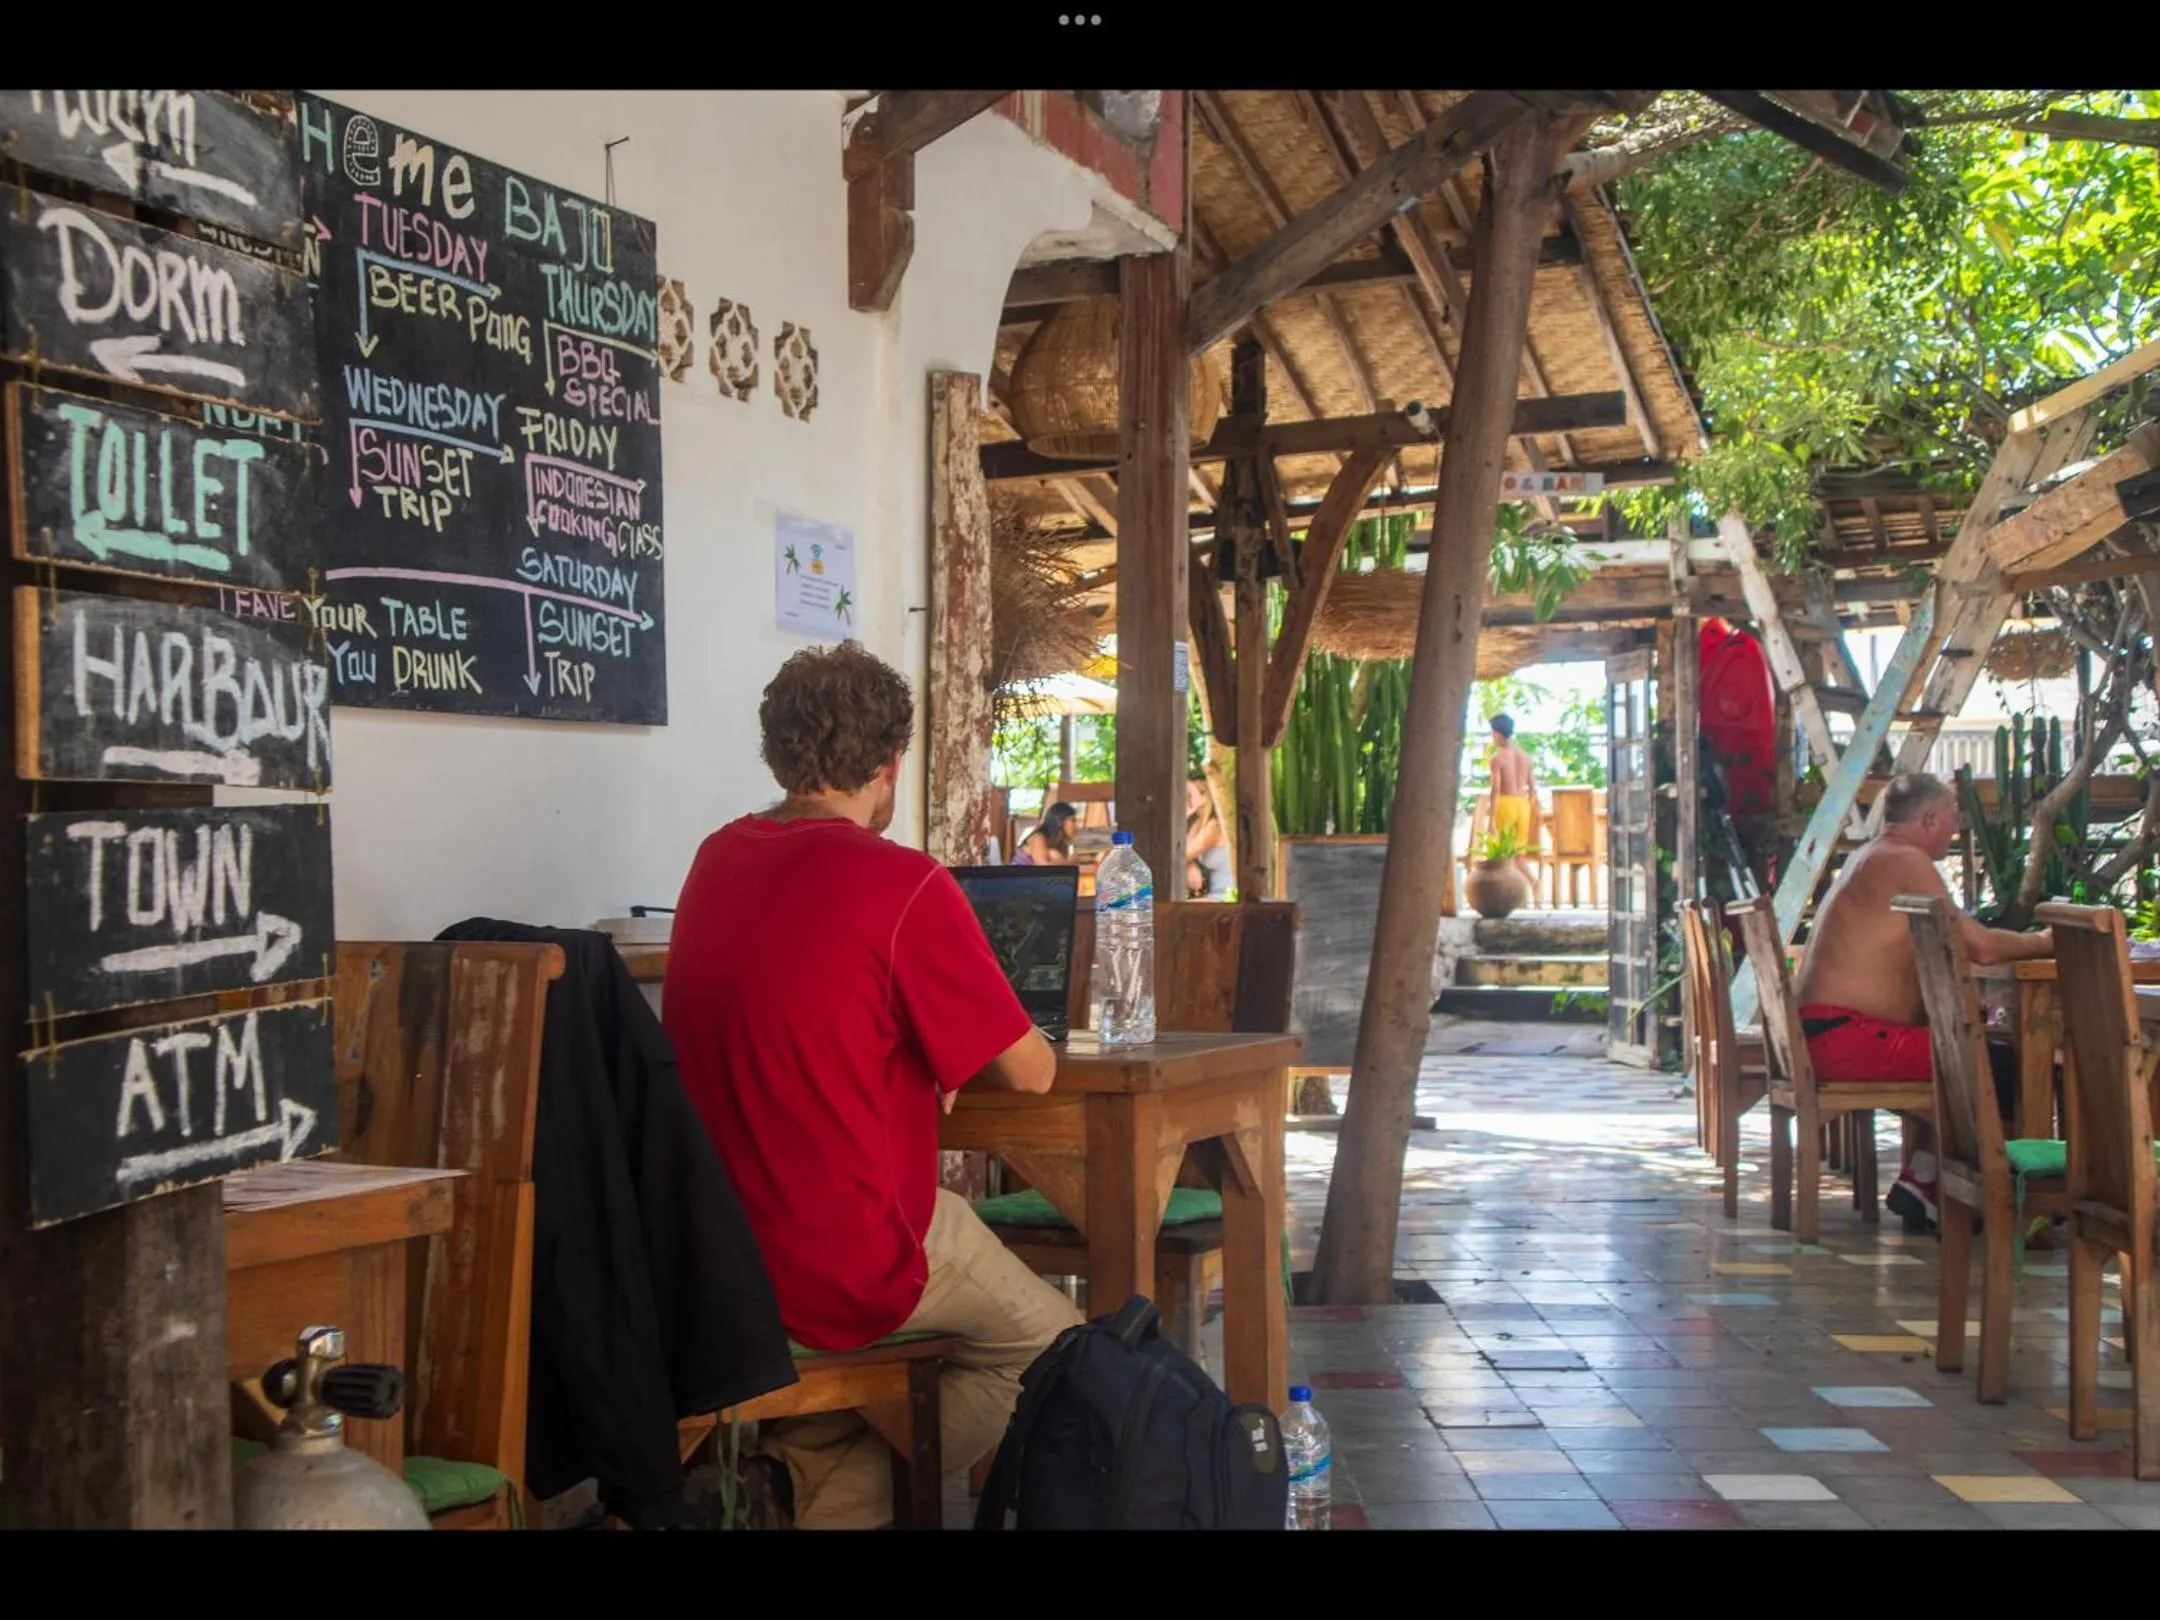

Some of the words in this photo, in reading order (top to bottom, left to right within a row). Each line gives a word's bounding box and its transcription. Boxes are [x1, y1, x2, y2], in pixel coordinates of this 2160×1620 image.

[353, 192, 488, 282] TUESDAY
[368, 264, 462, 322] BEER
[539, 263, 657, 343] THURSDAY
[557, 334, 621, 387] BBQ
[344, 365, 506, 444] WEDNESDAY
[563, 377, 661, 425] SPECIAL
[359, 428, 474, 498] SUNSET
[515, 406, 618, 471] FRIDAY
[59, 403, 265, 555] TOILET
[372, 486, 452, 532] TRIP
[536, 498, 617, 558] COOKING
[516, 546, 639, 612] SATURDAY
[302, 593, 378, 639] YOUR
[380, 596, 467, 641] TABLE
[538, 600, 636, 658] SUNSET
[73, 608, 331, 771] HARBOUR
[326, 640, 376, 685] YOU
[392, 646, 482, 695] DRUNK
[543, 651, 596, 702] TRIP
[67, 821, 252, 935] TOWN
[116, 1011, 268, 1137] ATM
